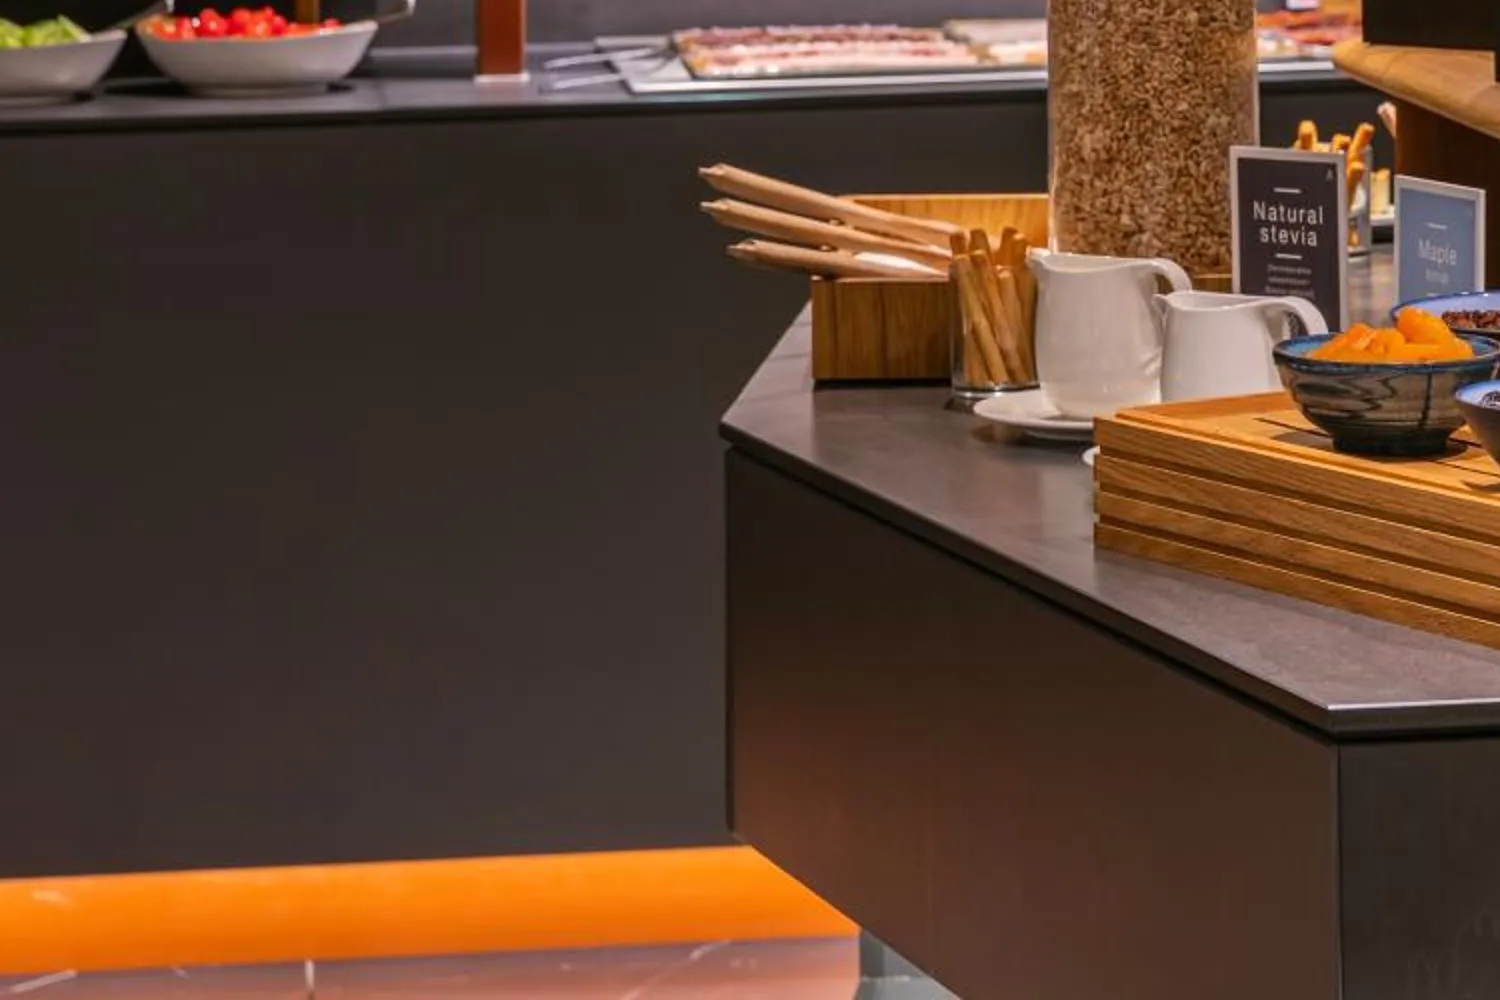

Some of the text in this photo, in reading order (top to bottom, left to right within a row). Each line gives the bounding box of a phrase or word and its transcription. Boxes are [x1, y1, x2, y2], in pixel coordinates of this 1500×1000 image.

[1253, 200, 1324, 225] Natural
[1260, 225, 1317, 247] stevia
[1418, 239, 1457, 269] Maple
